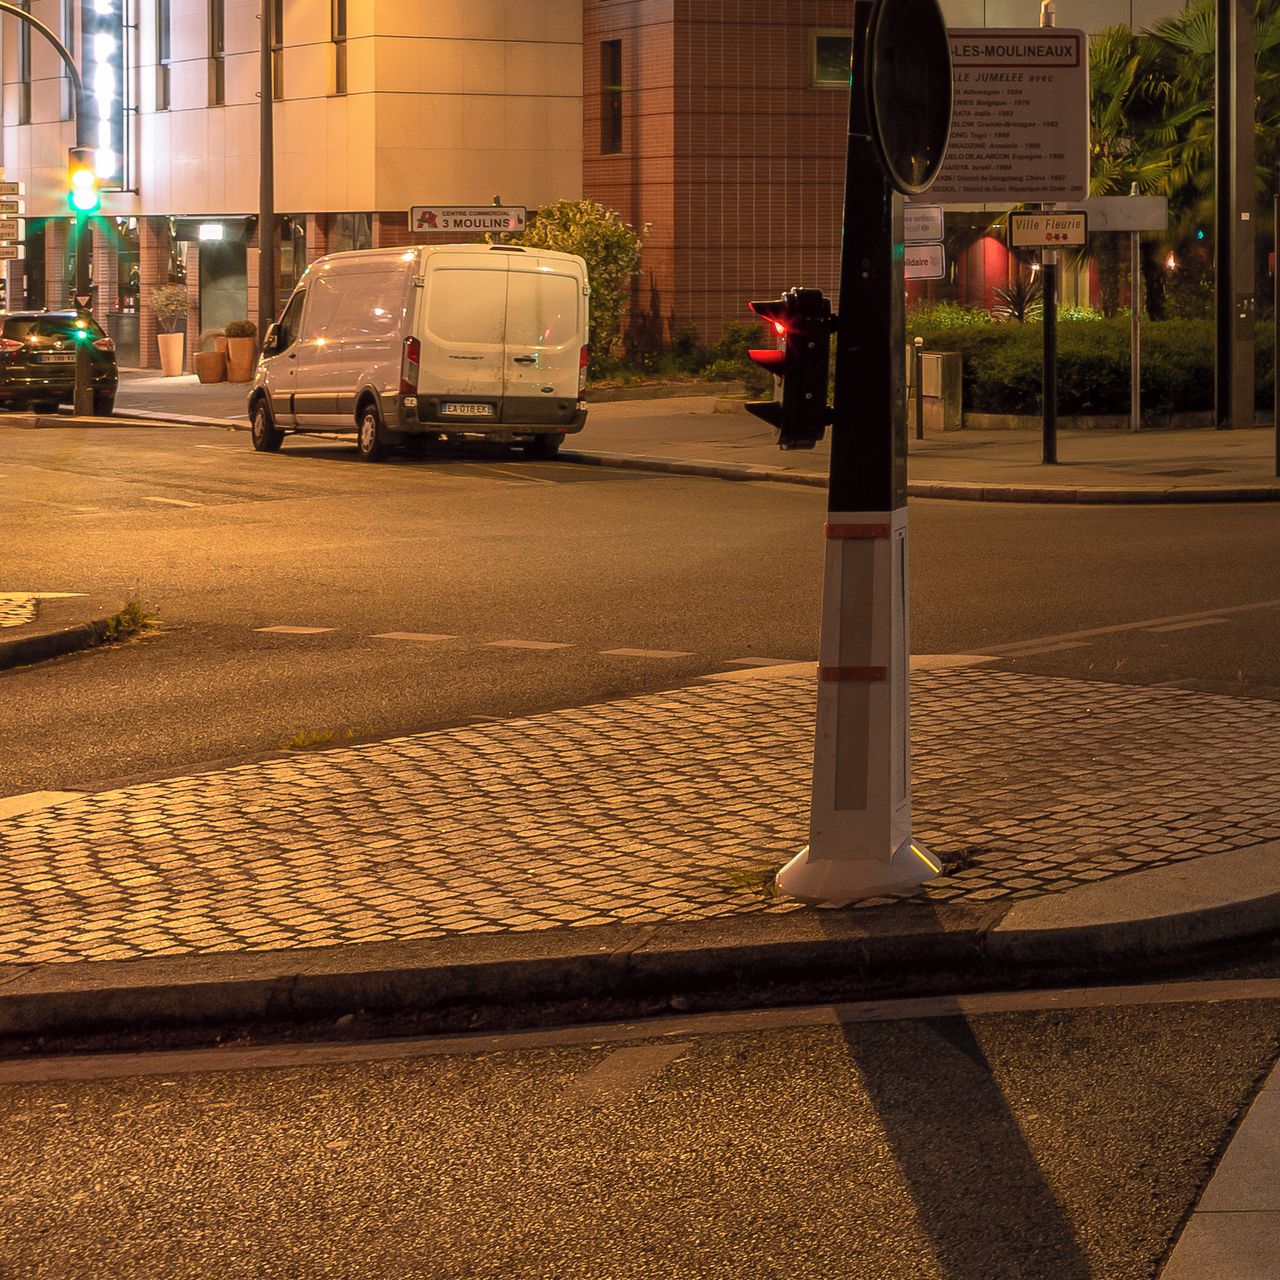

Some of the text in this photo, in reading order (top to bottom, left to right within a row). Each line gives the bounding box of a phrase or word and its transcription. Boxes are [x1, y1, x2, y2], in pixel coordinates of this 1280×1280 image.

[952, 45, 1073, 58] -LES-MOULINEAUX
[442, 219, 510, 228] 3 MOULINS
[1015, 218, 1081, 231] Ville Fleurie
